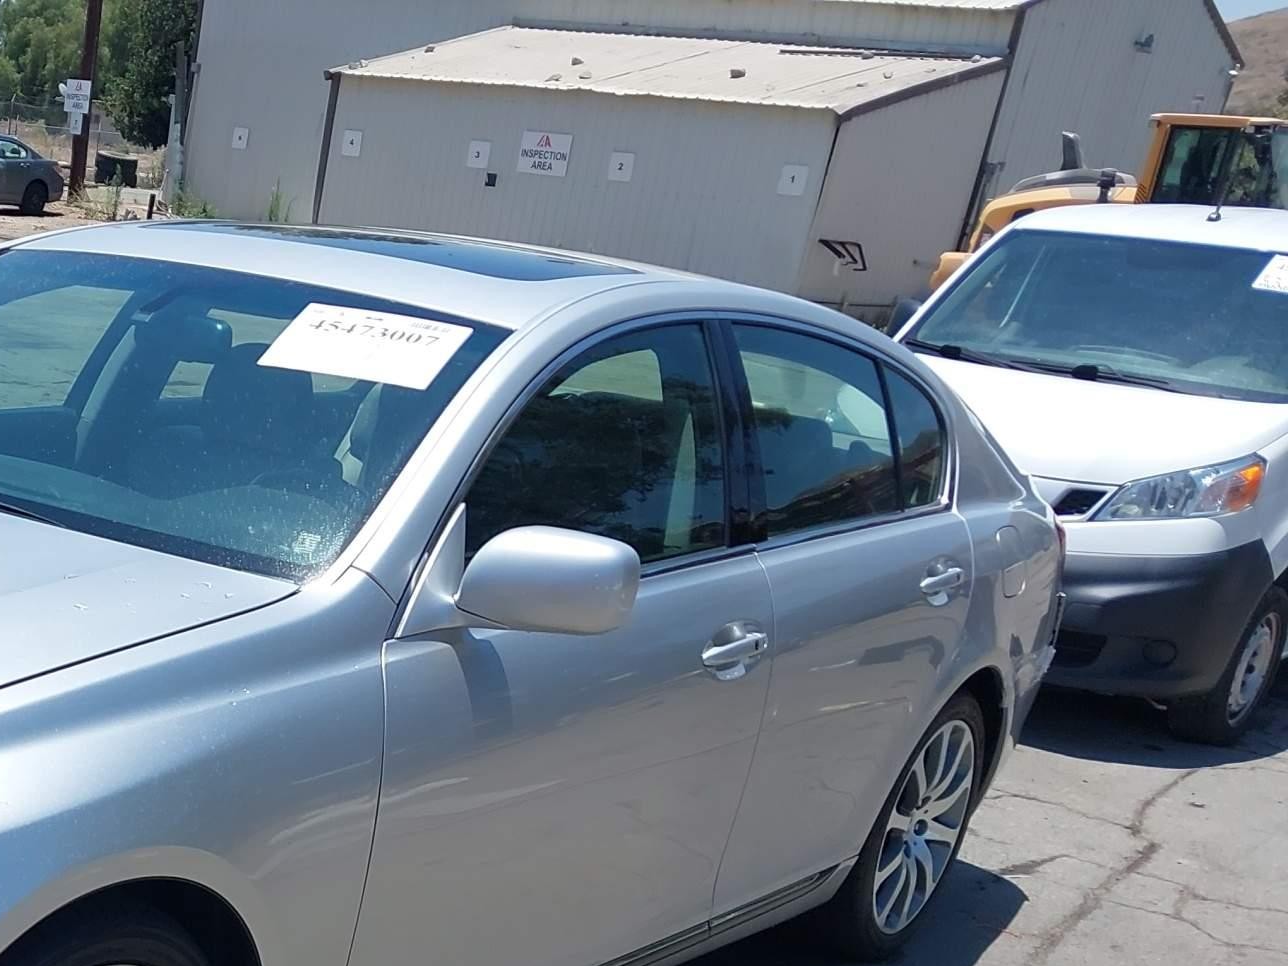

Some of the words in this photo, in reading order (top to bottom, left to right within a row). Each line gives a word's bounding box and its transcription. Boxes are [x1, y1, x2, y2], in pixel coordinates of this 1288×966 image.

[474, 151, 480, 159] 3
[521, 148, 567, 162] INSPECTION
[530, 161, 553, 171] AREA
[617, 162, 624, 171] 2
[309, 319, 440, 346] 45473007
